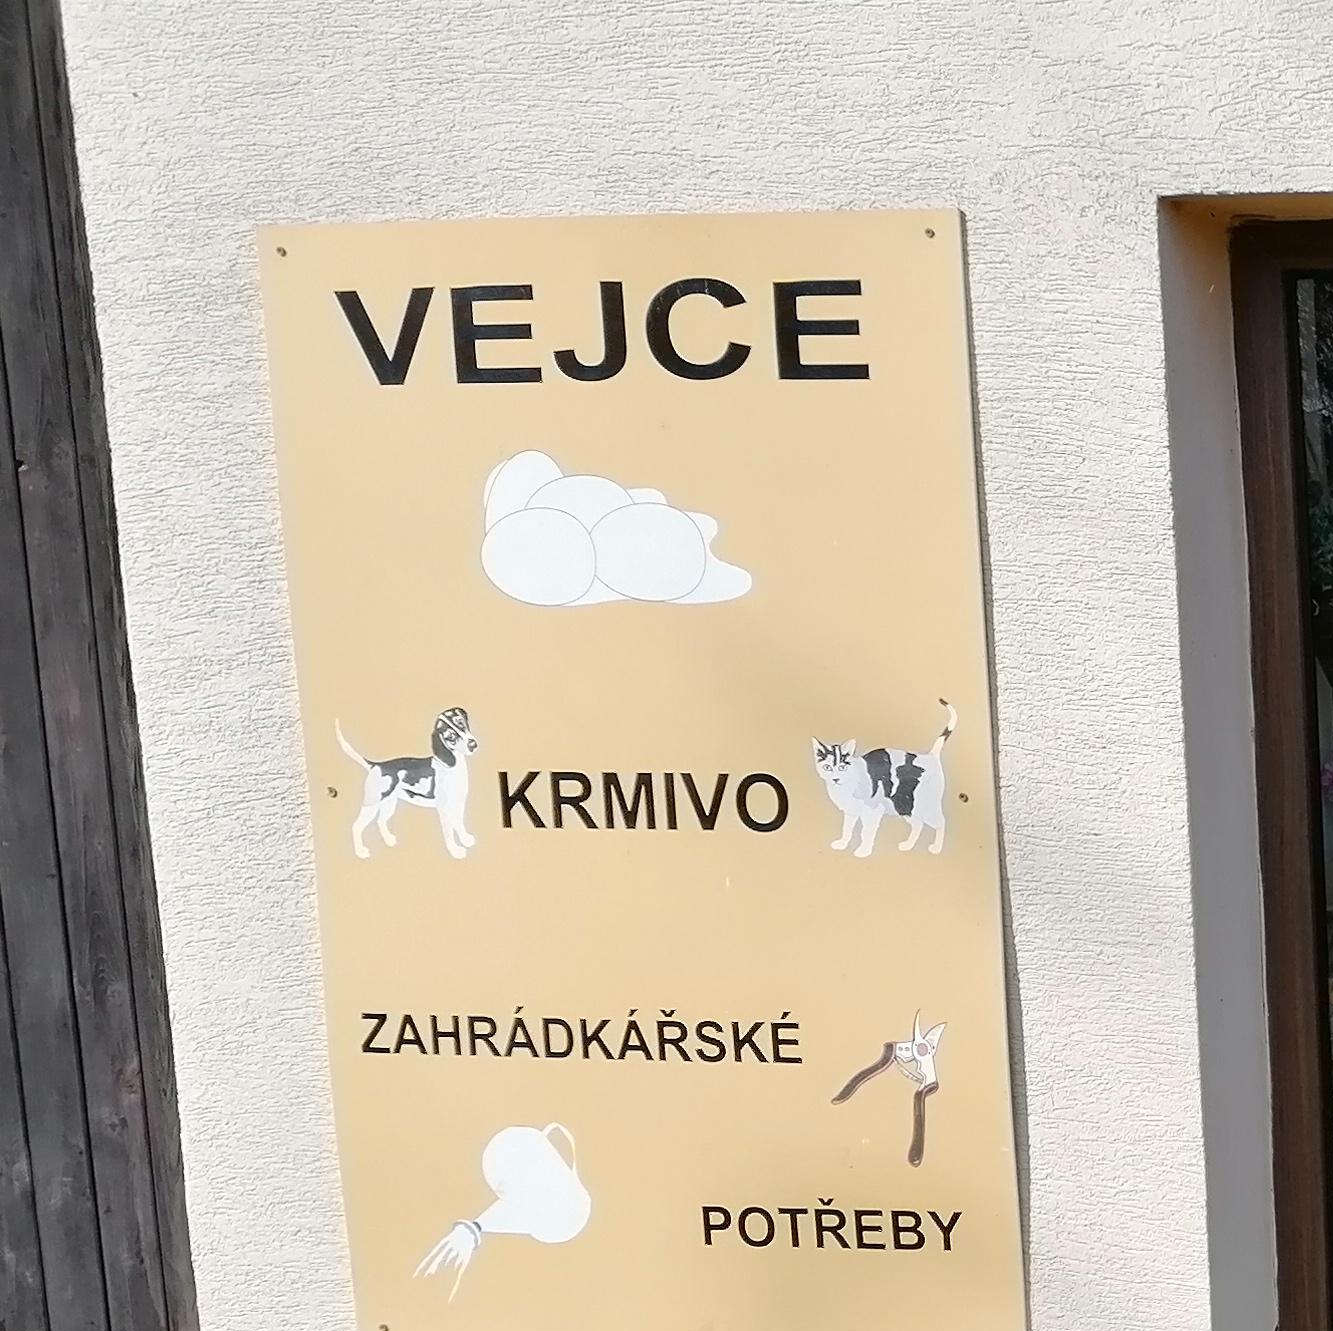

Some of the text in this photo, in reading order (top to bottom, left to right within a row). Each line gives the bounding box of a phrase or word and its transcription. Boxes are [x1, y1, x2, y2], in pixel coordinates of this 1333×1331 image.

[334, 278, 871, 387] VEJCE
[499, 770, 790, 834] KRMIVO
[360, 1006, 803, 1065] ZAHRÁDKÁŘSKÉ
[701, 1198, 962, 1252] POTŘEBY
